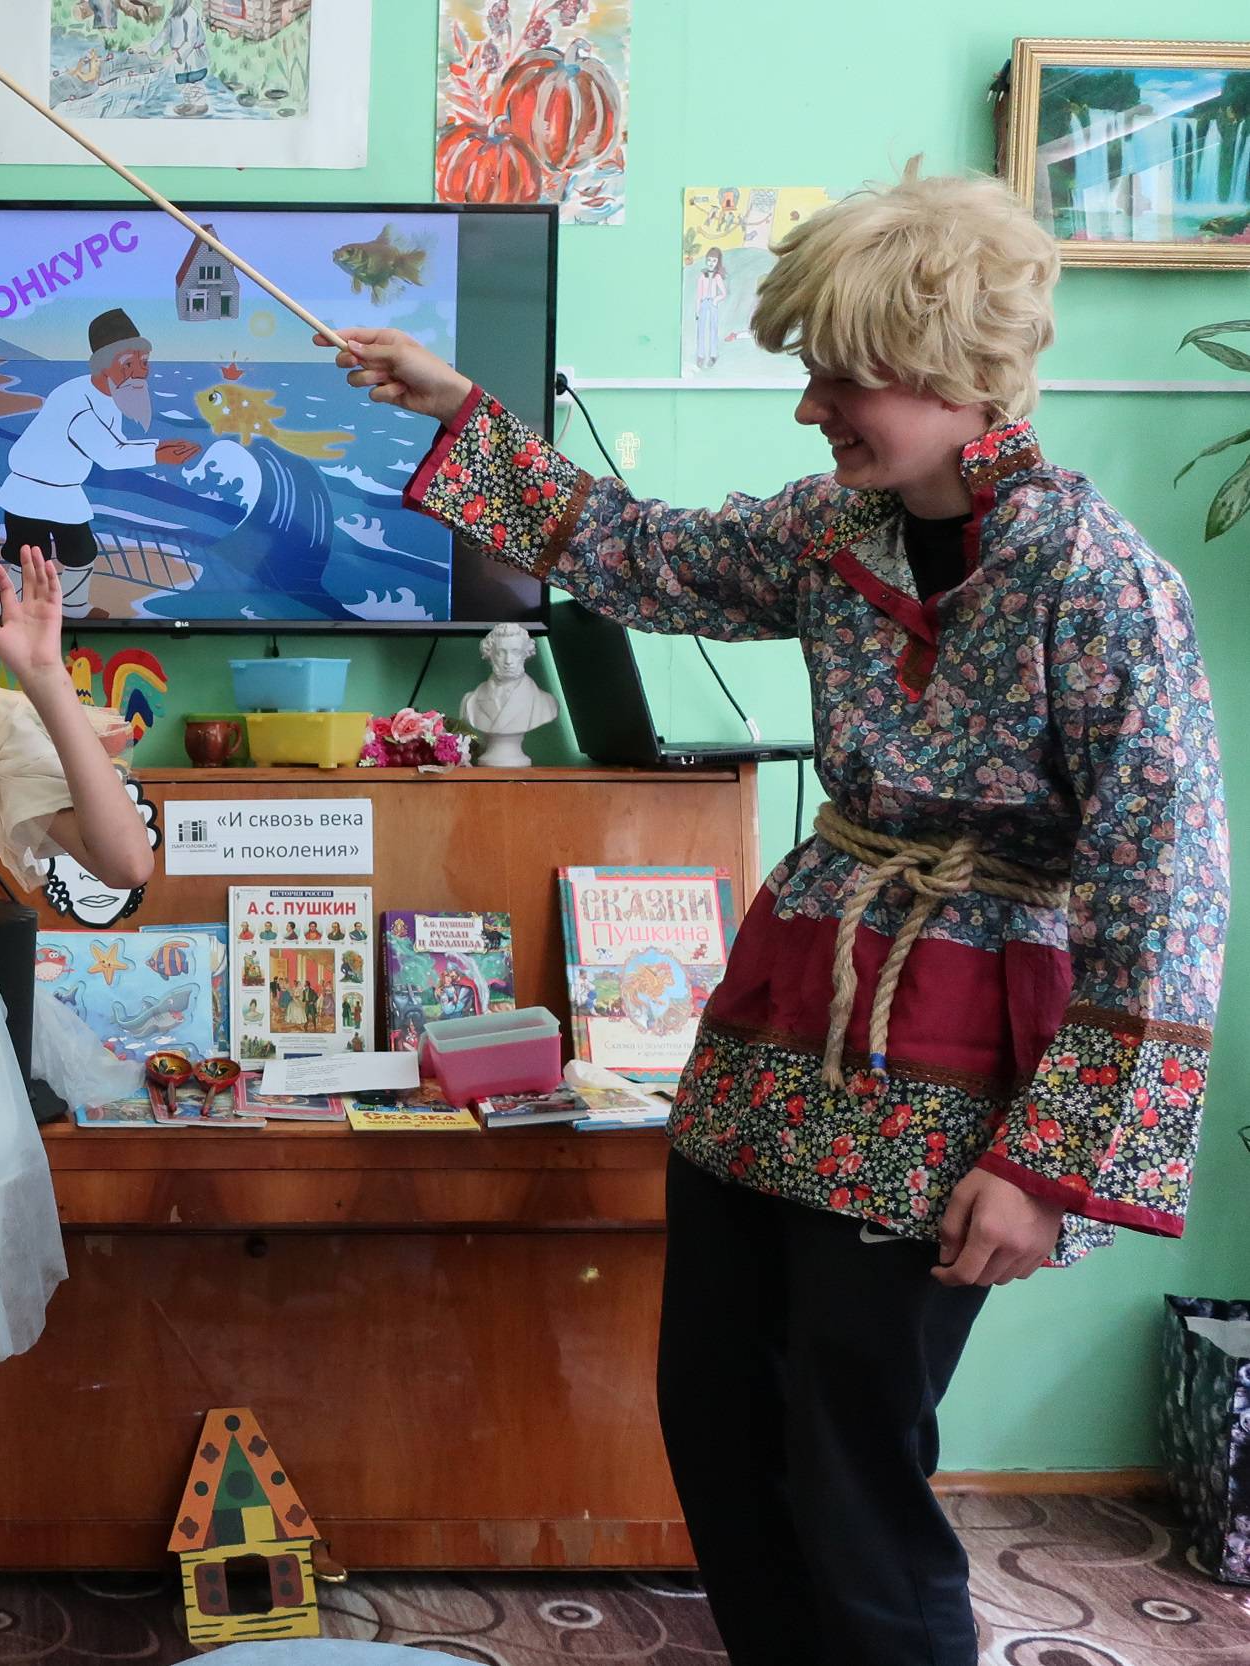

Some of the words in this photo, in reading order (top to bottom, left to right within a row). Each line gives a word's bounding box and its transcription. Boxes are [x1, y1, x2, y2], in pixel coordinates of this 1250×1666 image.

[217, 811, 242, 827] «И
[249, 813, 313, 827] сквозь
[320, 812, 363, 826] века
[223, 847, 234, 859] и
[241, 844, 359, 858] поколения»
[247, 902, 279, 915] А.С.
[284, 902, 356, 915] ПУШКИН
[580, 887, 714, 922] СКАЗКИ
[591, 923, 710, 946] Пушкина
